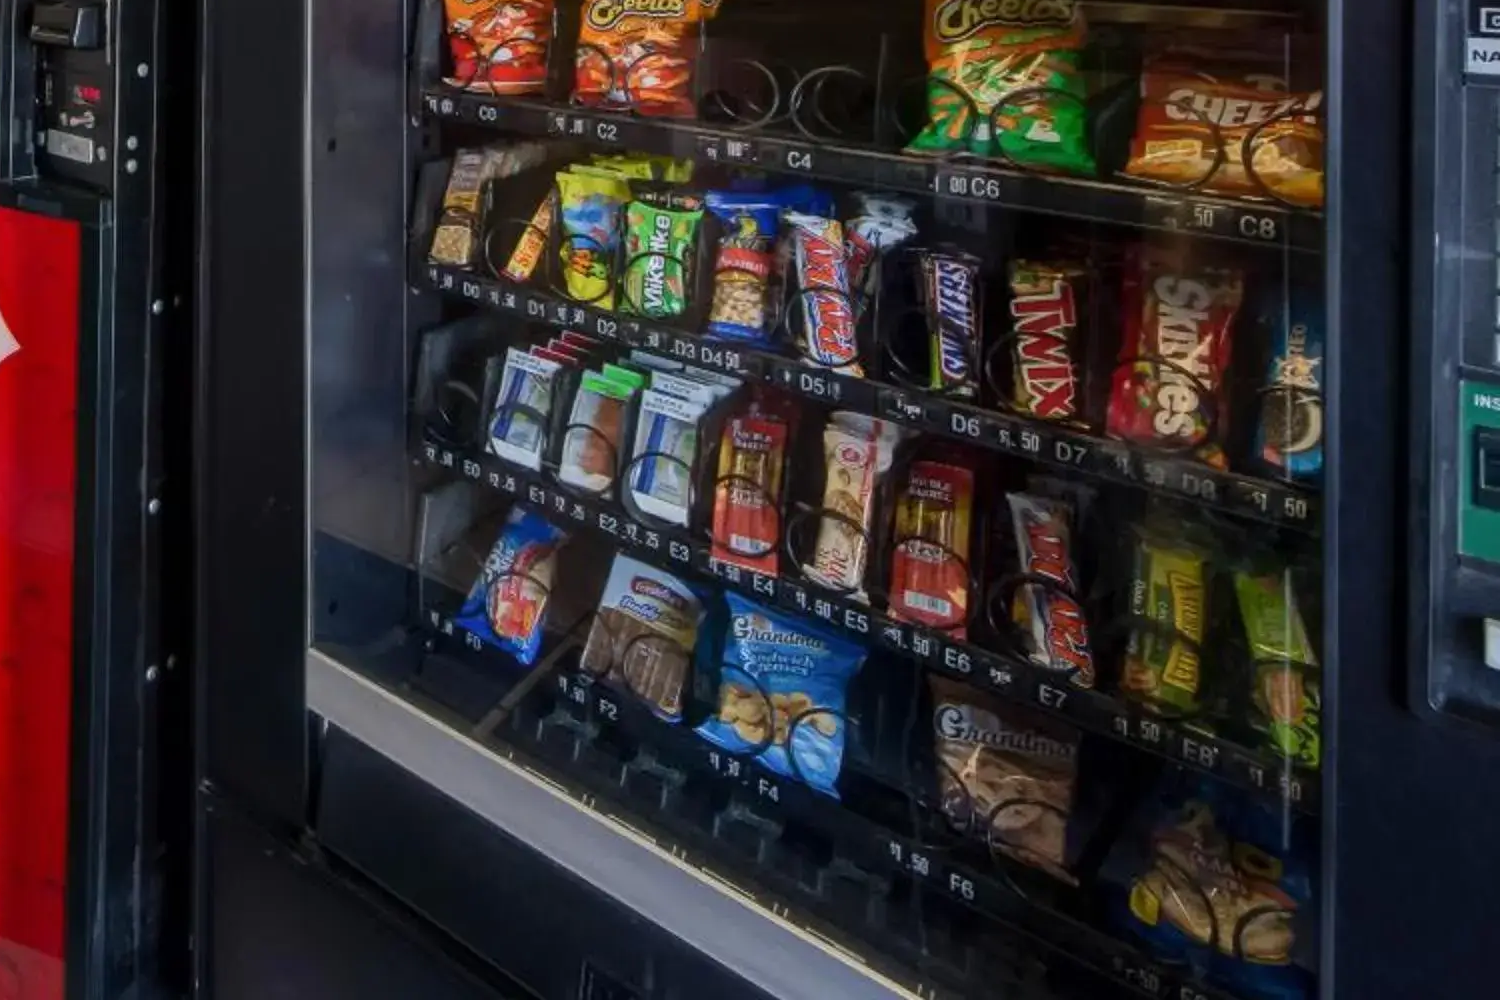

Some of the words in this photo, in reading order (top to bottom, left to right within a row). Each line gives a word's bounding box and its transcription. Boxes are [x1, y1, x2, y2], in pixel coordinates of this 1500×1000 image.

[597, 124, 617, 141] C2
[787, 151, 813, 170] C4
[971, 179, 1000, 199] C6
[1239, 215, 1276, 239] C8
[463, 281, 481, 299] D0
[527, 299, 545, 318] D1
[597, 318, 617, 337] D2
[1010, 280, 1076, 418] TWIX
[674, 339, 696, 359] D3
[701, 346, 722, 366] D4
[801, 373, 825, 396] D5
[950, 412, 981, 437] D6
[1054, 441, 1089, 465] D7
[463, 459, 481, 479] E0
[528, 485, 545, 505] E1
[599, 513, 617, 534] E2
[669, 541, 690, 562] E3
[753, 573, 775, 596] E4
[844, 610, 869, 633] E5
[943, 647, 971, 673] E6
[1038, 683, 1069, 708] E7
[758, 778, 780, 802] F4
[949, 872, 976, 901] F6
